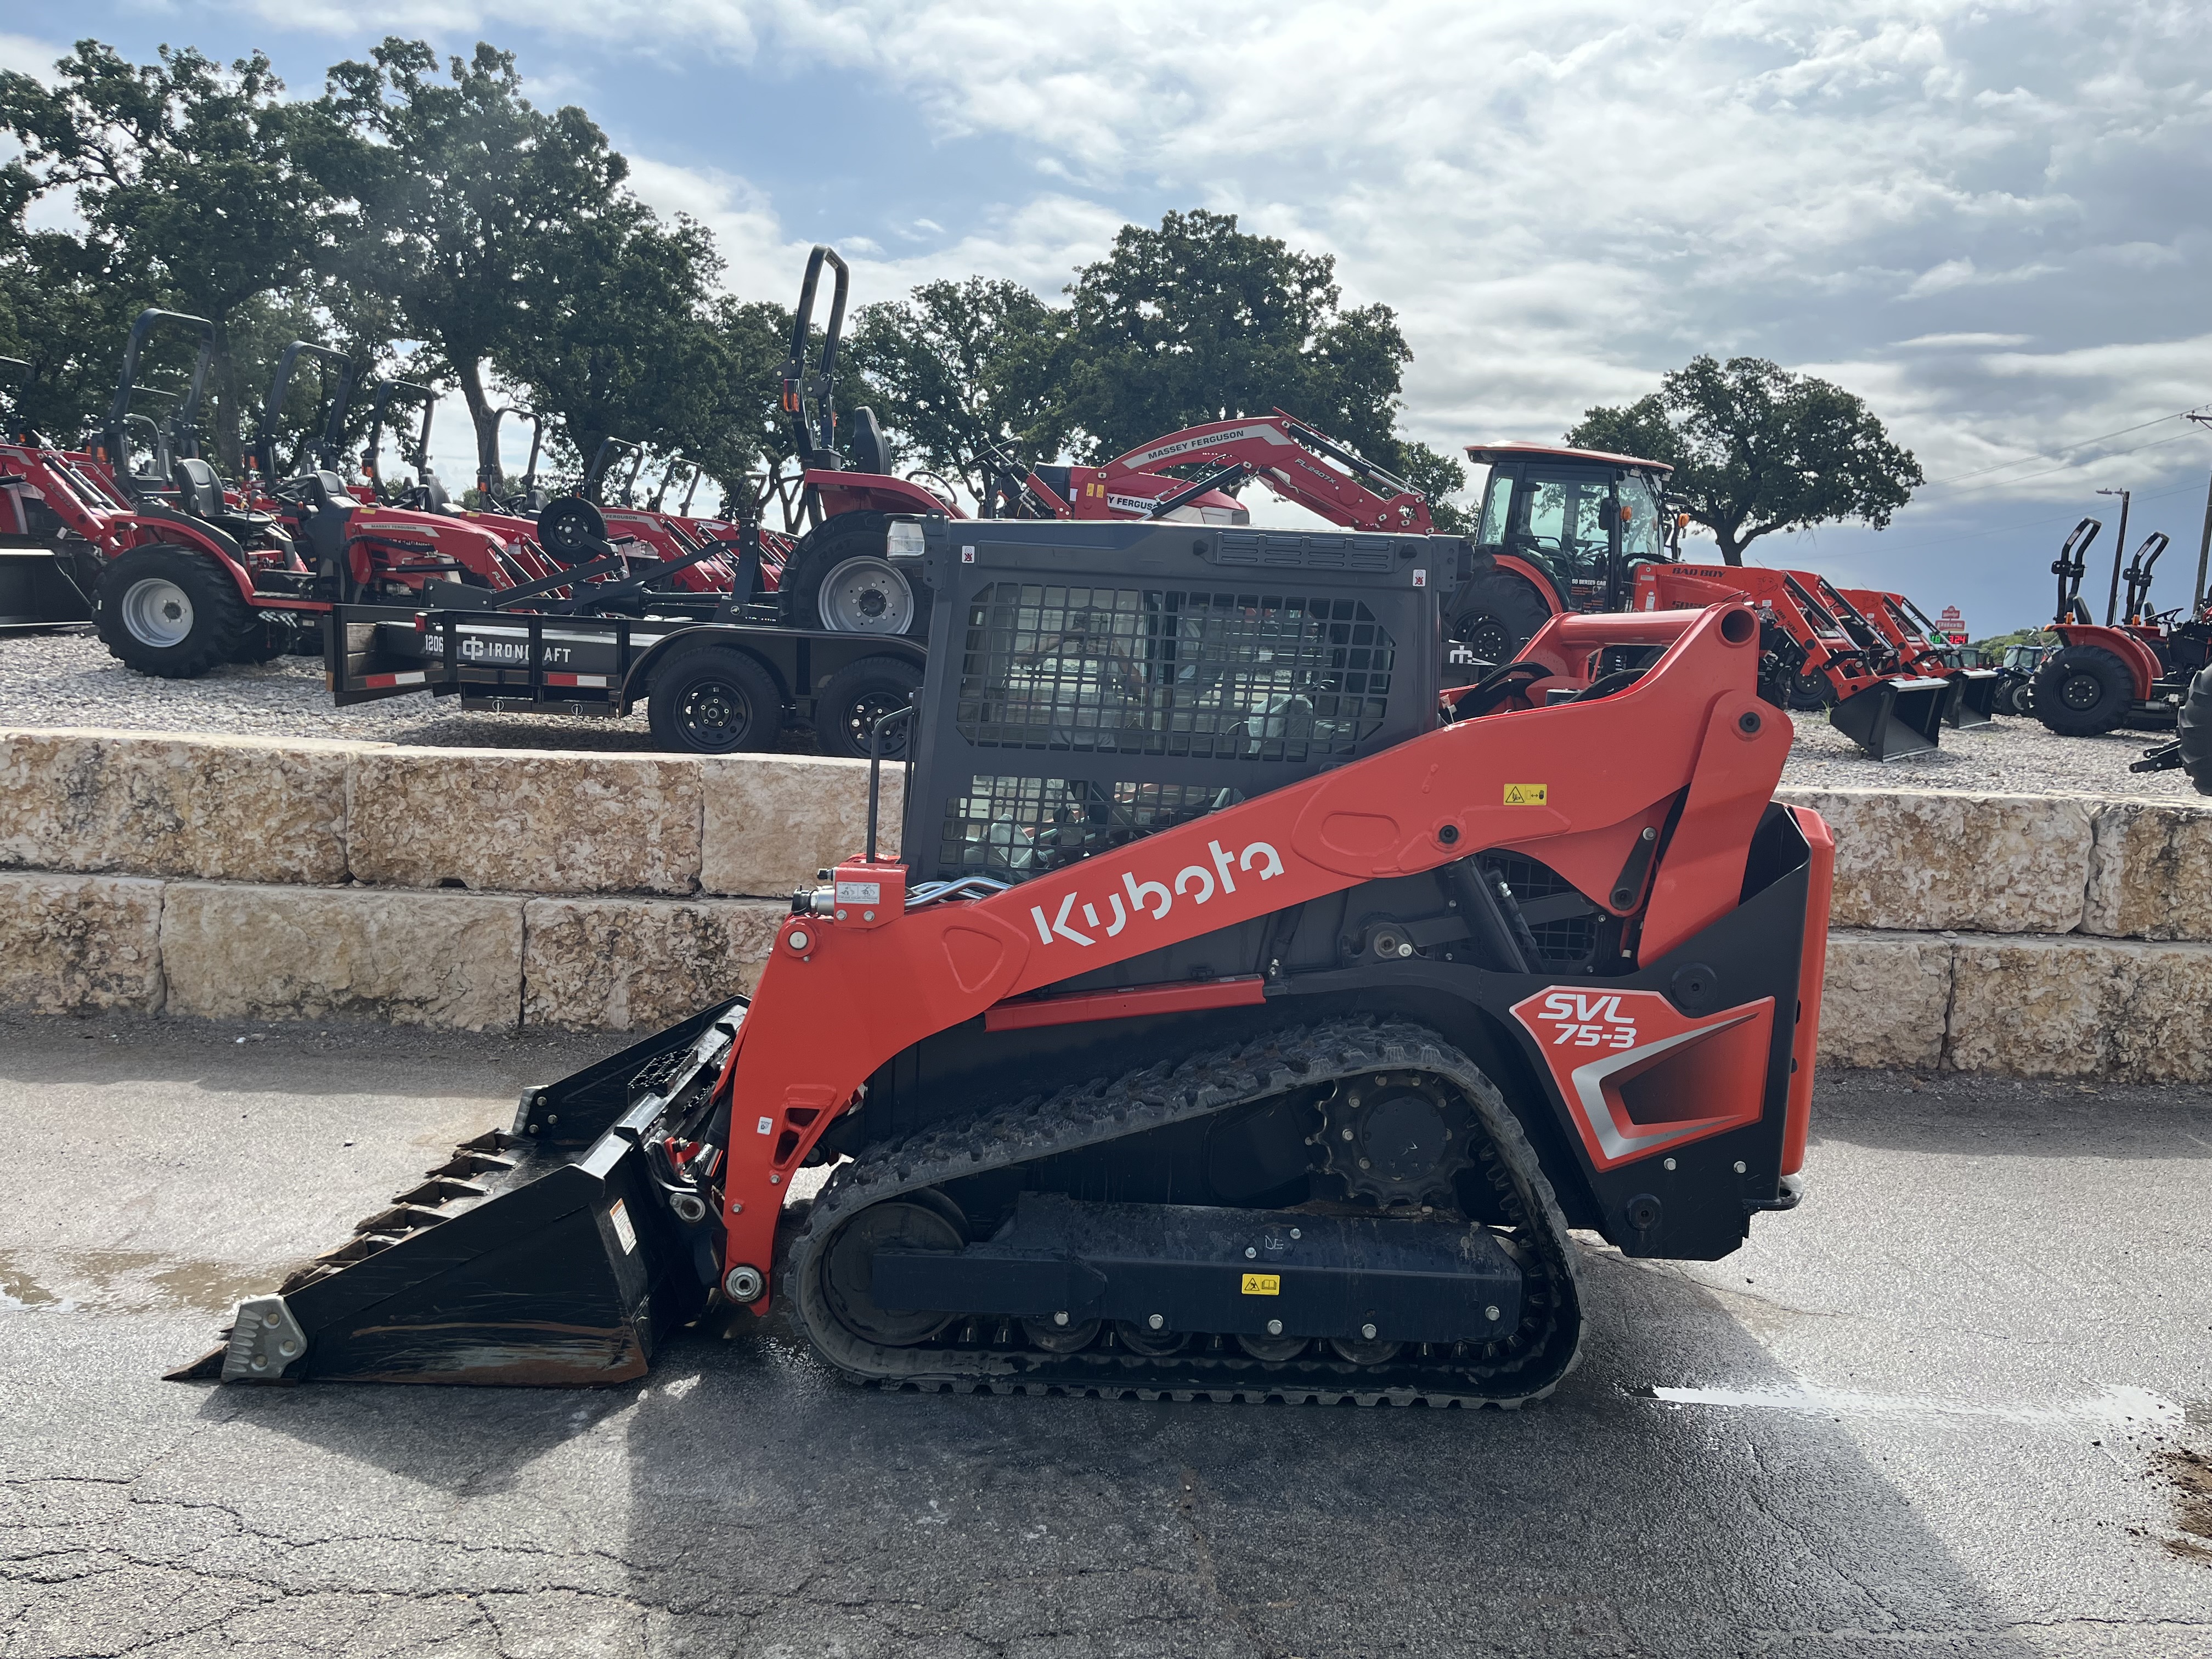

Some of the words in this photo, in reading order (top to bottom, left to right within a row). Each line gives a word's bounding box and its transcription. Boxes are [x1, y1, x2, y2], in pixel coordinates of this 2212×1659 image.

[1148, 443, 1188, 460] MASSEY
[1192, 430, 1244, 447] FERGUSON
[1295, 458, 1337, 484] FL2407X
[1117, 498, 1158, 510] FERGUS
[1700, 569, 1726, 578] BOY
[425, 634, 444, 652] 1206
[1030, 840, 1284, 946] Kubota
[1538, 993, 1635, 1024] SVL
[1553, 1023, 1637, 1048] 75-3
